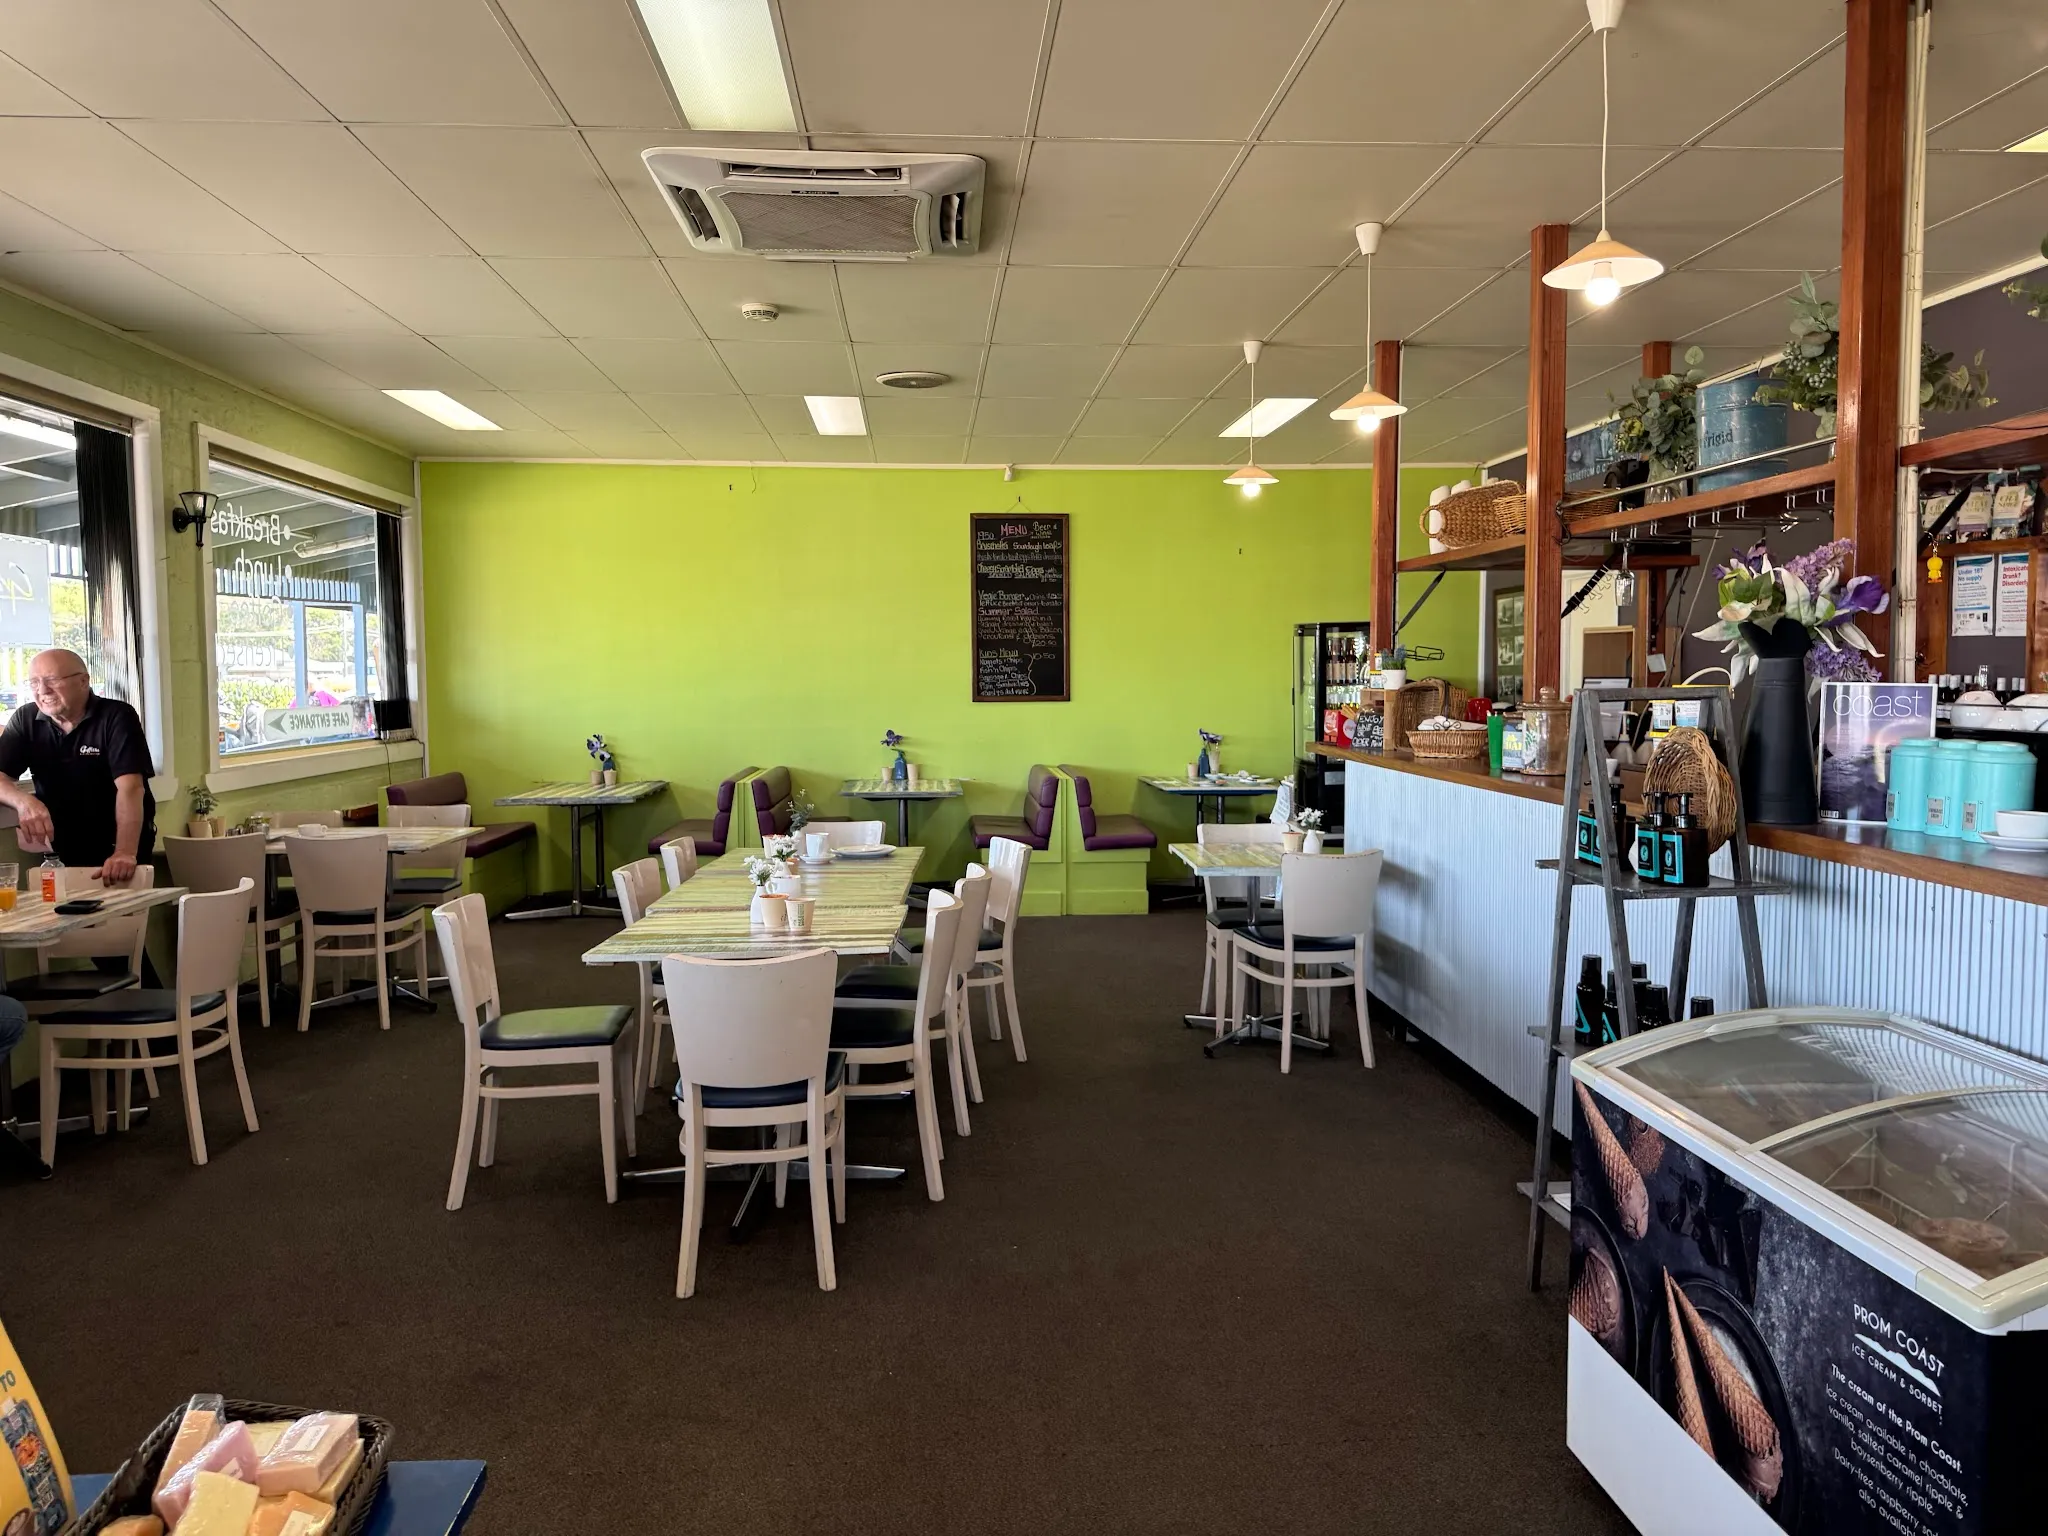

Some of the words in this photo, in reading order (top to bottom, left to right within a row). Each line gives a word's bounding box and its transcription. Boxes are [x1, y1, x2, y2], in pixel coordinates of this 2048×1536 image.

[1000, 522, 1028, 537] MENU
[2003, 564, 2029, 573] Intoxicate
[2003, 572, 2021, 580] Drunk?
[978, 607, 1013, 616] Summer
[1014, 606, 1039, 615] Salad
[979, 649, 998, 658] KIDS
[1360, 715, 1384, 723] ENJOY
[1832, 689, 1924, 718] coast
[1853, 1303, 1891, 1338] PROM
[1895, 1330, 1945, 1377] COAST
[1851, 1342, 1865, 1360] ICE
[1867, 1355, 1897, 1382] CREAM
[1899, 1377, 1906, 1388] &
[1909, 1384, 1943, 1415] SORBET
[1831, 1363, 1846, 1383] The
[1847, 1380, 1874, 1406] cream
[1876, 1401, 1887, 1415] of
[1888, 1408, 1903, 1428] the
[1905, 1419, 1928, 1446] Prom
[1930, 1440, 1963, 1475] Coast.
[1825, 1382, 1838, 1401] Ice
[1839, 1397, 1864, 1422] cream
[1865, 1418, 1907, 1456] available
[1908, 1449, 1917, 1464] in
[1919, 1460, 1969, 1508] chocolate,
[1828, 1404, 1856, 1434] vanilla,
[1857, 1428, 1885, 1456] salted
[1886, 1452, 1923, 1487] caramel
[1925, 1483, 1954, 1512] ripple
[1850, 1437, 1904, 1490] boysenberry
[1833, 1447, 1874, 1490] Dairy-free
[1876, 1486, 1920, 1529] raspberry
[1858, 1488, 1877, 1509] also
[1878, 1506, 1916, 1536] availab
